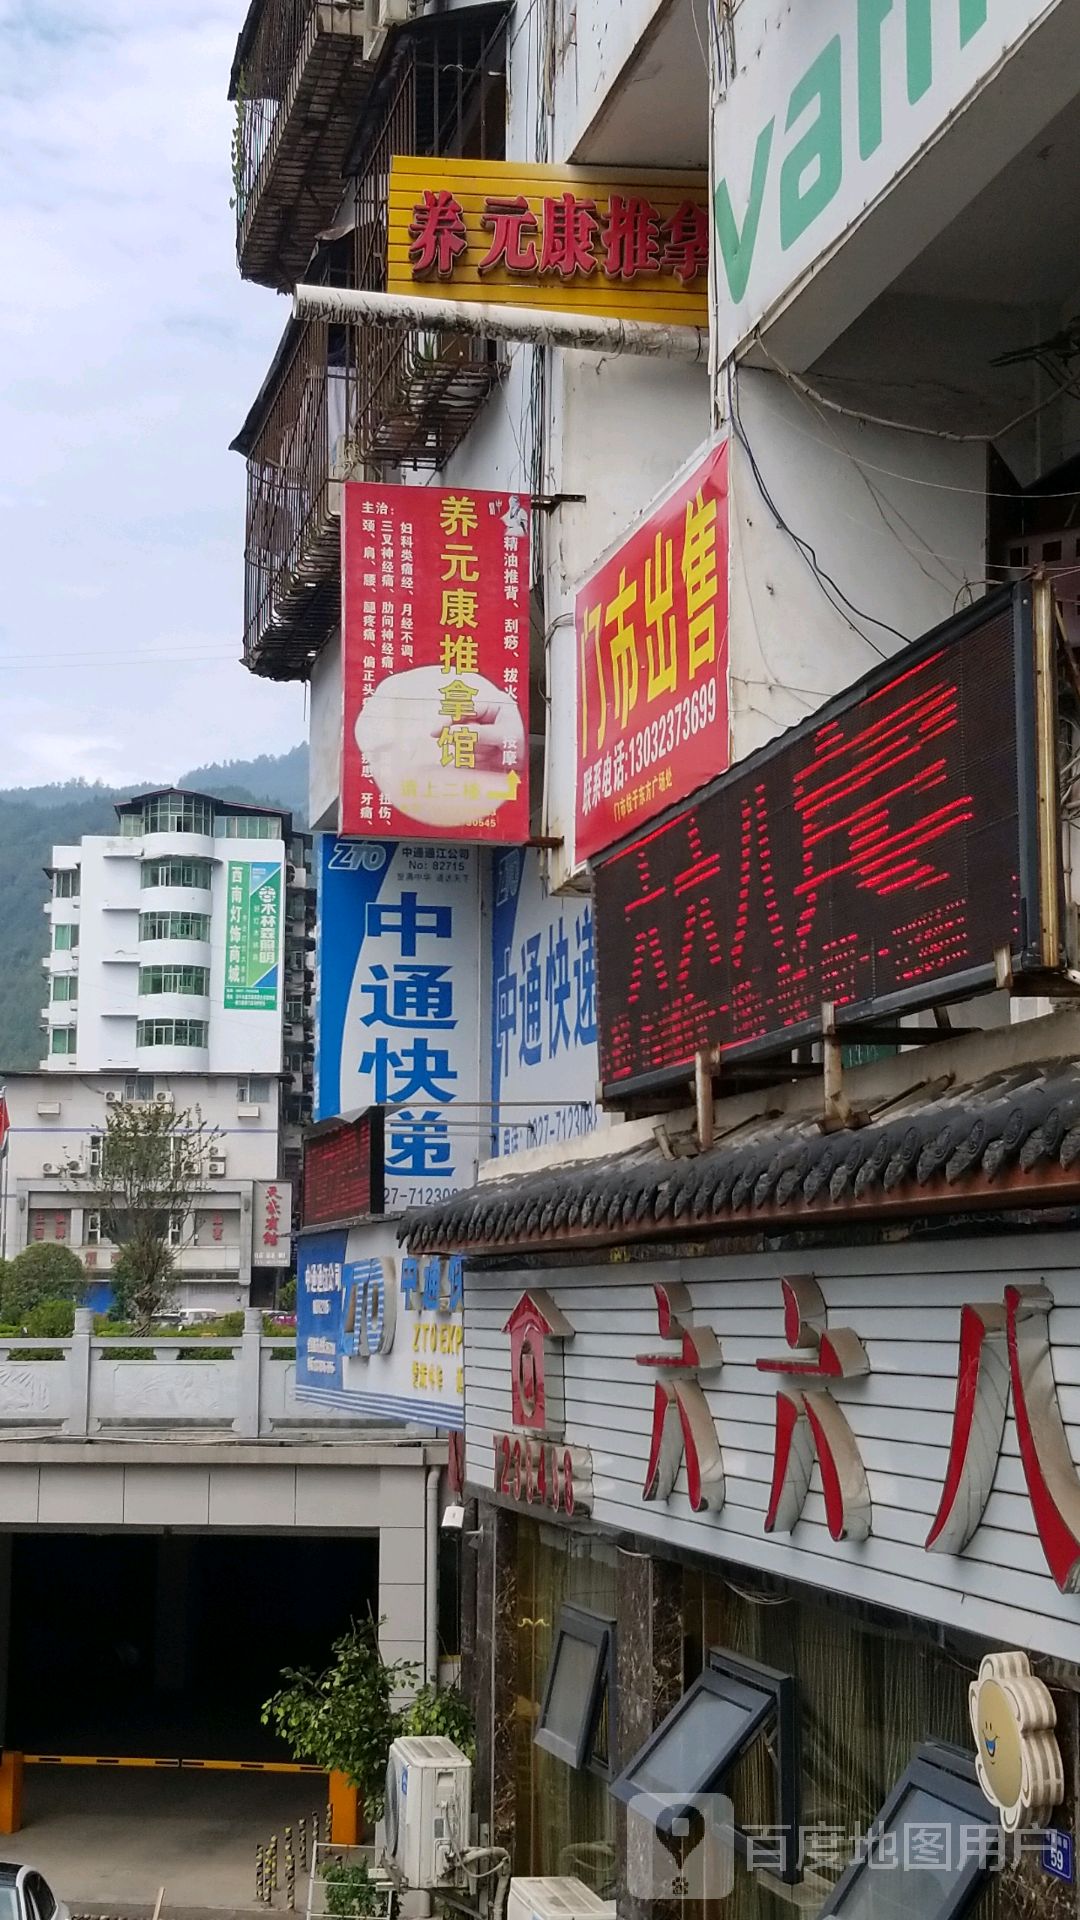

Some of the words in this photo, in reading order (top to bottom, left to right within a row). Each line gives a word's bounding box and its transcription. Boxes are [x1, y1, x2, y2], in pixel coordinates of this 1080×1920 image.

[437, 496, 479, 769] 养元康推拿馆
[581, 485, 717, 759] 门市出售
[328, 843, 387, 871] ZTO
[357, 892, 458, 1177] 中通快递
[636, 1274, 1080, 1594] 六六八
